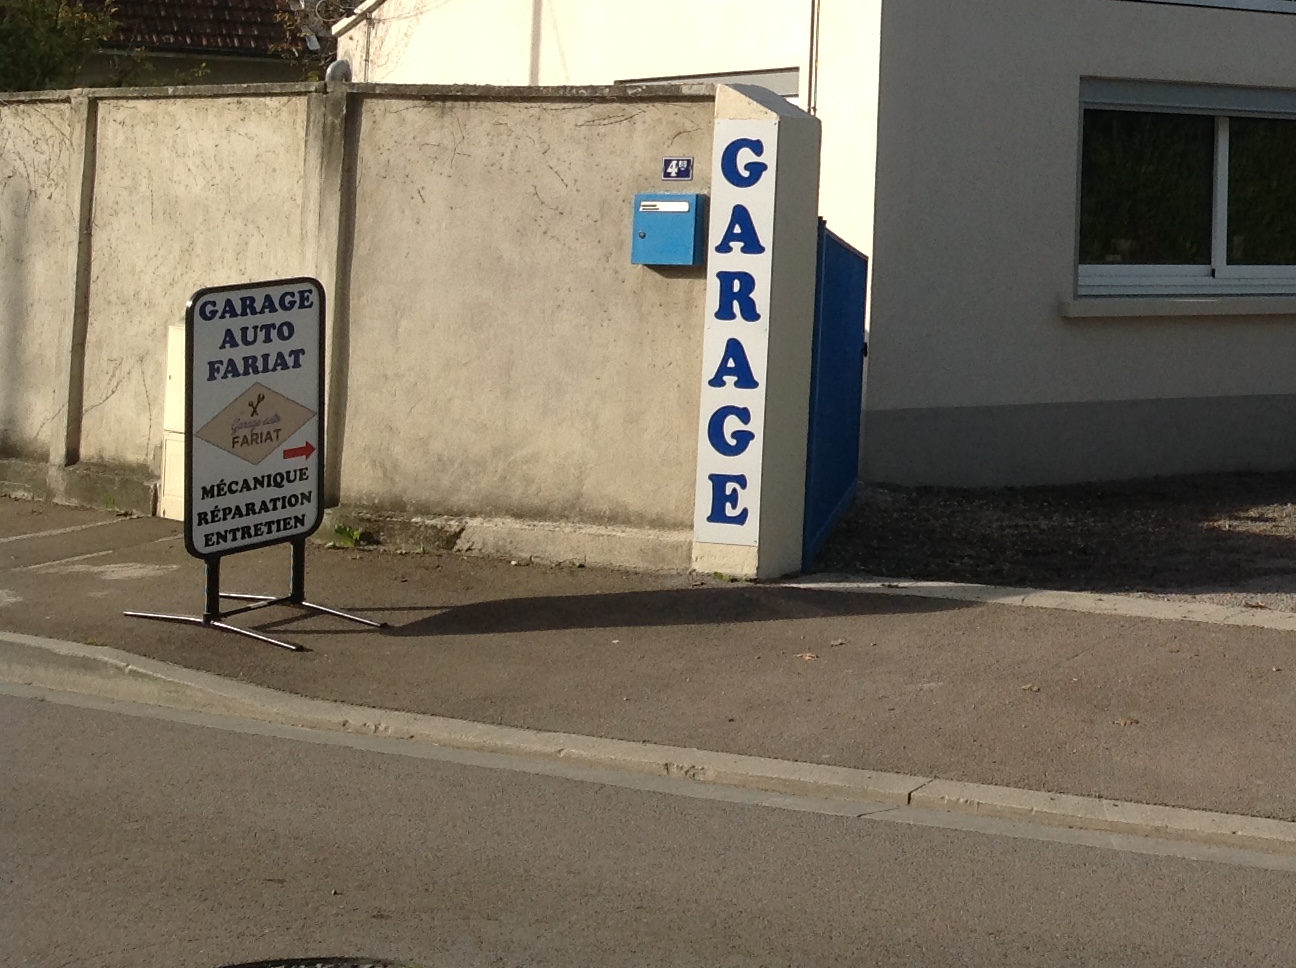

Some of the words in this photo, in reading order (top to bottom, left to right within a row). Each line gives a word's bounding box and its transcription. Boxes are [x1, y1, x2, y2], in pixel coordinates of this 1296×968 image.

[198, 288, 315, 322] GARAGE
[218, 320, 296, 351] AUTO
[706, 137, 769, 527] GARAGE
[206, 348, 306, 382] FARIAT
[231, 428, 282, 449] FARIAT
[200, 467, 310, 502] MÉCANIQUE
[196, 490, 313, 527] RÉPARATION
[203, 513, 307, 549] ENTRETIEN
